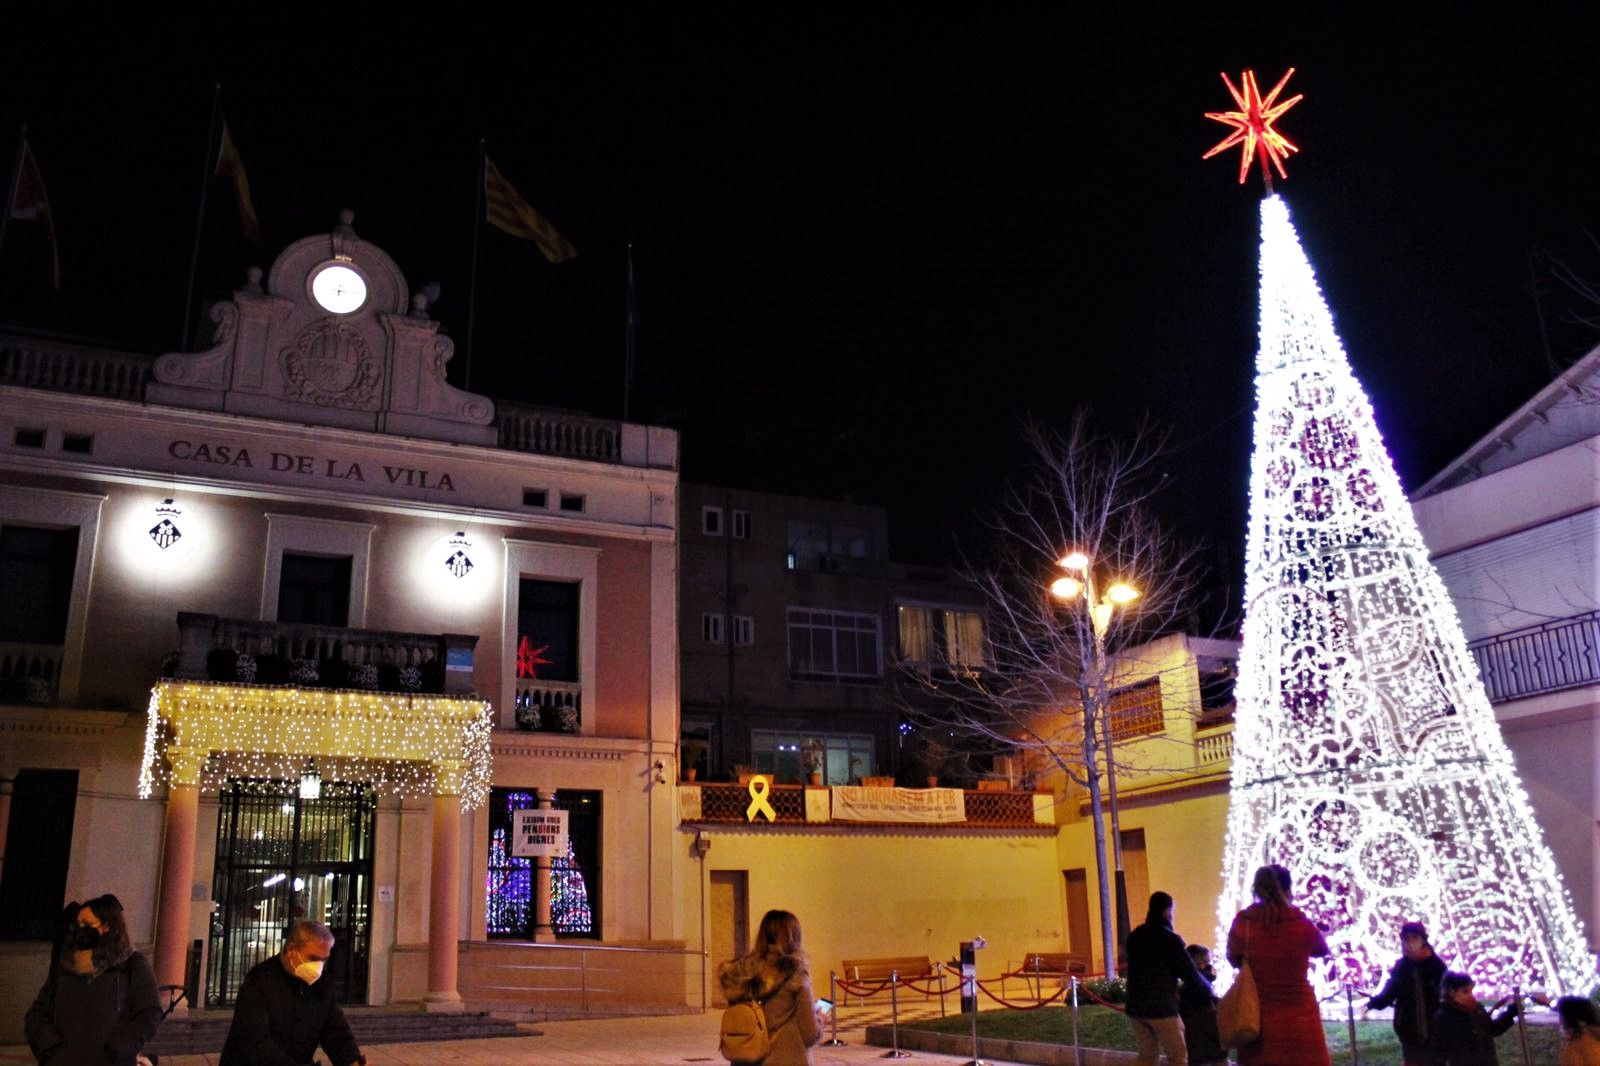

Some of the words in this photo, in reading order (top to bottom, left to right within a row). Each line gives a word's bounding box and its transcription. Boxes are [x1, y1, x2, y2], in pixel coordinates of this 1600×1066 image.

[168, 440, 253, 469] CASA
[270, 452, 314, 475] DE
[325, 459, 365, 482] LA
[382, 465, 457, 492] VILA
[522, 824, 560, 834] PENSIONS
[527, 835, 555, 845] DIGNES
